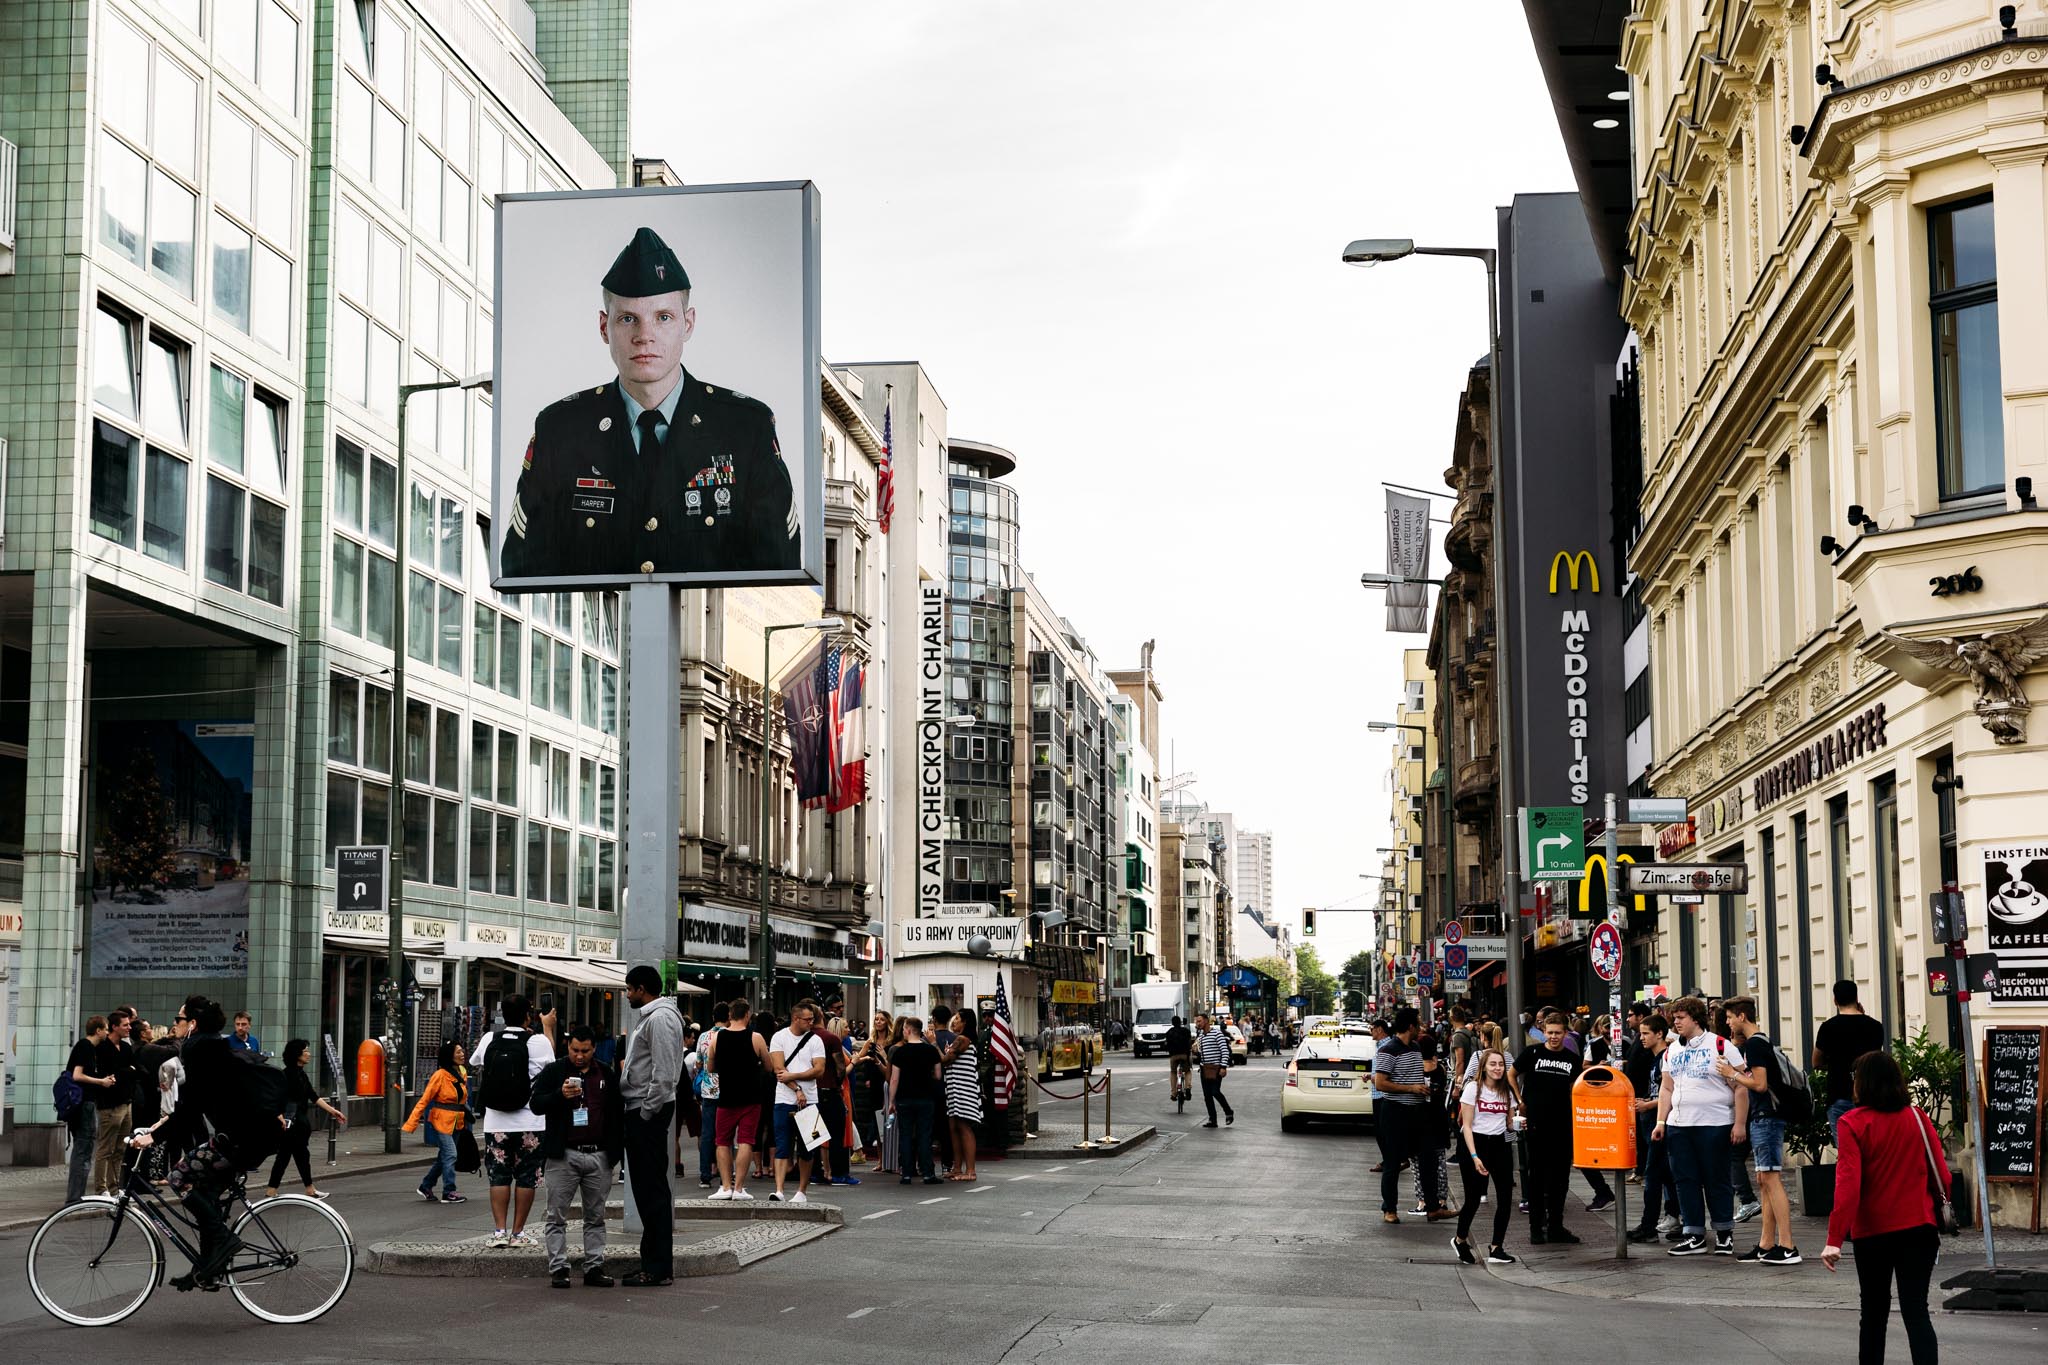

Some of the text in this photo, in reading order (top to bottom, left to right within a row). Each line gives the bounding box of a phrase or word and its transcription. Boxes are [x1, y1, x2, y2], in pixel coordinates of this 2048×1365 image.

[581, 500, 604, 508] HARPER
[1416, 510, 1423, 524] we
[1404, 510, 1414, 586] human withot
[1416, 544, 1424, 562] less
[1929, 566, 1983, 597] 206
[1561, 610, 1590, 804] McDonalds
[922, 588, 942, 918] US AM CHECKPOINT CHARLIE
[1754, 748, 1812, 812] EINSTEIN
[1822, 702, 1886, 775] KAFFEE
[1984, 848, 2048, 859] EINSTEIN
[942, 906, 982, 914] ALLIED CHECKPOINT
[328, 912, 383, 932] CHECKPOINT CHARLIE
[413, 921, 446, 937] WALL MUSEUM
[477, 928, 507, 944] MAUERMUSEUM
[685, 918, 746, 948] HECKPOINT CHARLIE
[907, 926, 922, 941] US
[926, 926, 954, 941] ARMY
[1991, 934, 2048, 945] KAFFEE
[529, 934, 565, 950] CHECKPOINT CHARLIE
[579, 939, 612, 954] CHECKPOINT CHARLIE
[2000, 978, 2048, 986] HECKPOINT
[1535, 1058, 1572, 1074] THRASHER
[1585, 1116, 1598, 1124] dirty
[1595, 1108, 1616, 1116] leaving
[2010, 1141, 2033, 1149] more
